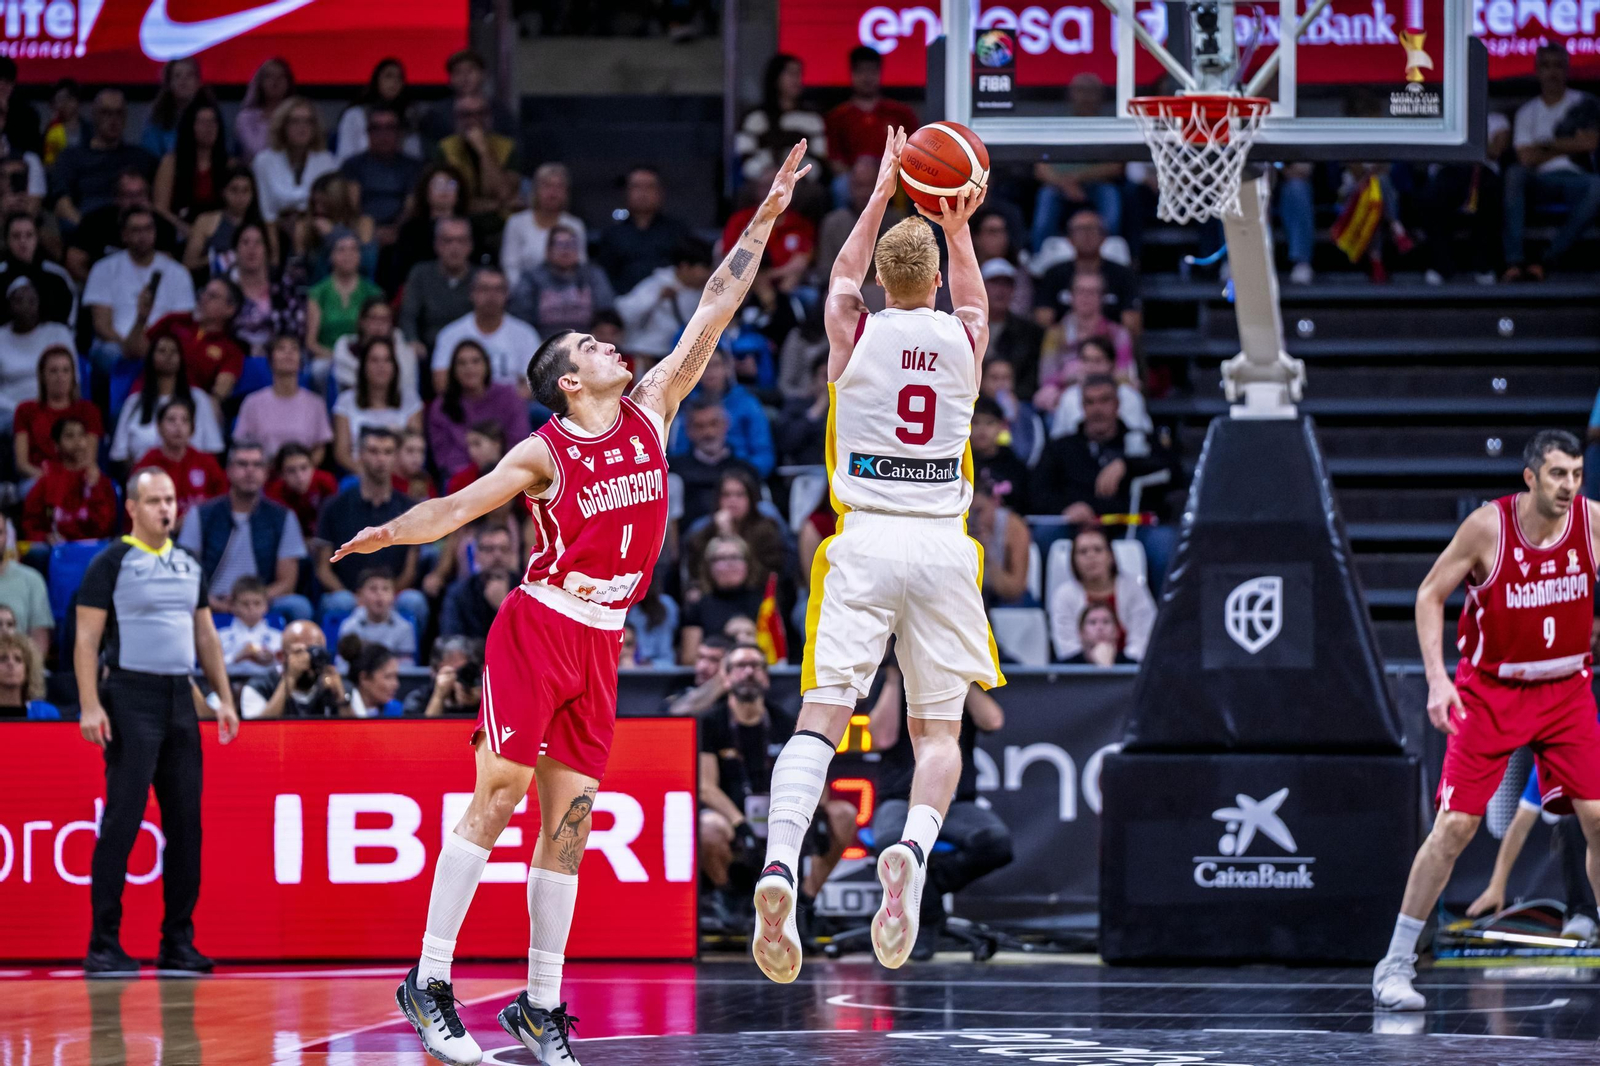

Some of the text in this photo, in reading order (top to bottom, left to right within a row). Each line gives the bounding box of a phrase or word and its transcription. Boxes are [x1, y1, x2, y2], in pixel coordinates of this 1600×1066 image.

[0, 0, 106, 58] ife!
[979, 75, 1011, 92] FIBA
[1390, 103, 1440, 116] QUALIFIERS
[924, 138, 942, 152] FIBA
[907, 153, 940, 177] molten
[901, 346, 939, 372] DÍAZ
[895, 384, 937, 446] 9
[875, 458, 956, 481] CaixaBank
[1543, 616, 1556, 649] 9
[273, 791, 694, 887] IBERI
[1193, 862, 1315, 889] CaixaBank
